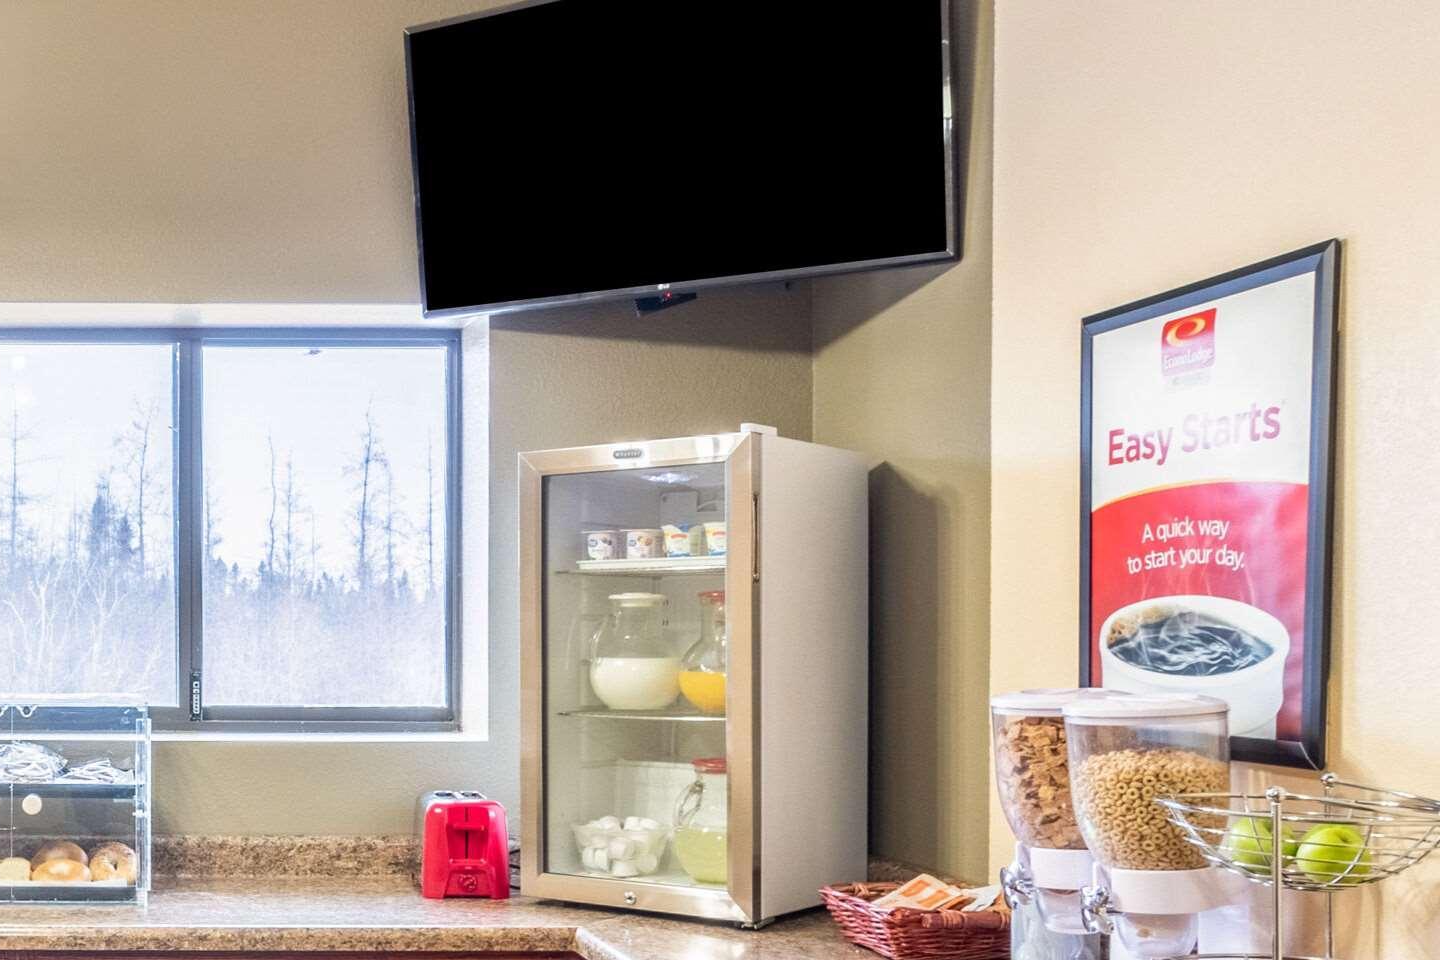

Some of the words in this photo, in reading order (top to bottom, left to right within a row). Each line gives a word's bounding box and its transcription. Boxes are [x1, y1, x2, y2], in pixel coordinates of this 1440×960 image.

[1108, 427, 1173, 466] Easy
[1181, 403, 1281, 453] Starts
[1141, 523, 1155, 543] A
[1156, 516, 1195, 543] quick
[1198, 519, 1230, 540] way
[1127, 556, 1143, 575] to
[1144, 546, 1177, 570] start
[1179, 547, 1213, 569] your
[1215, 543, 1245, 571] day.
